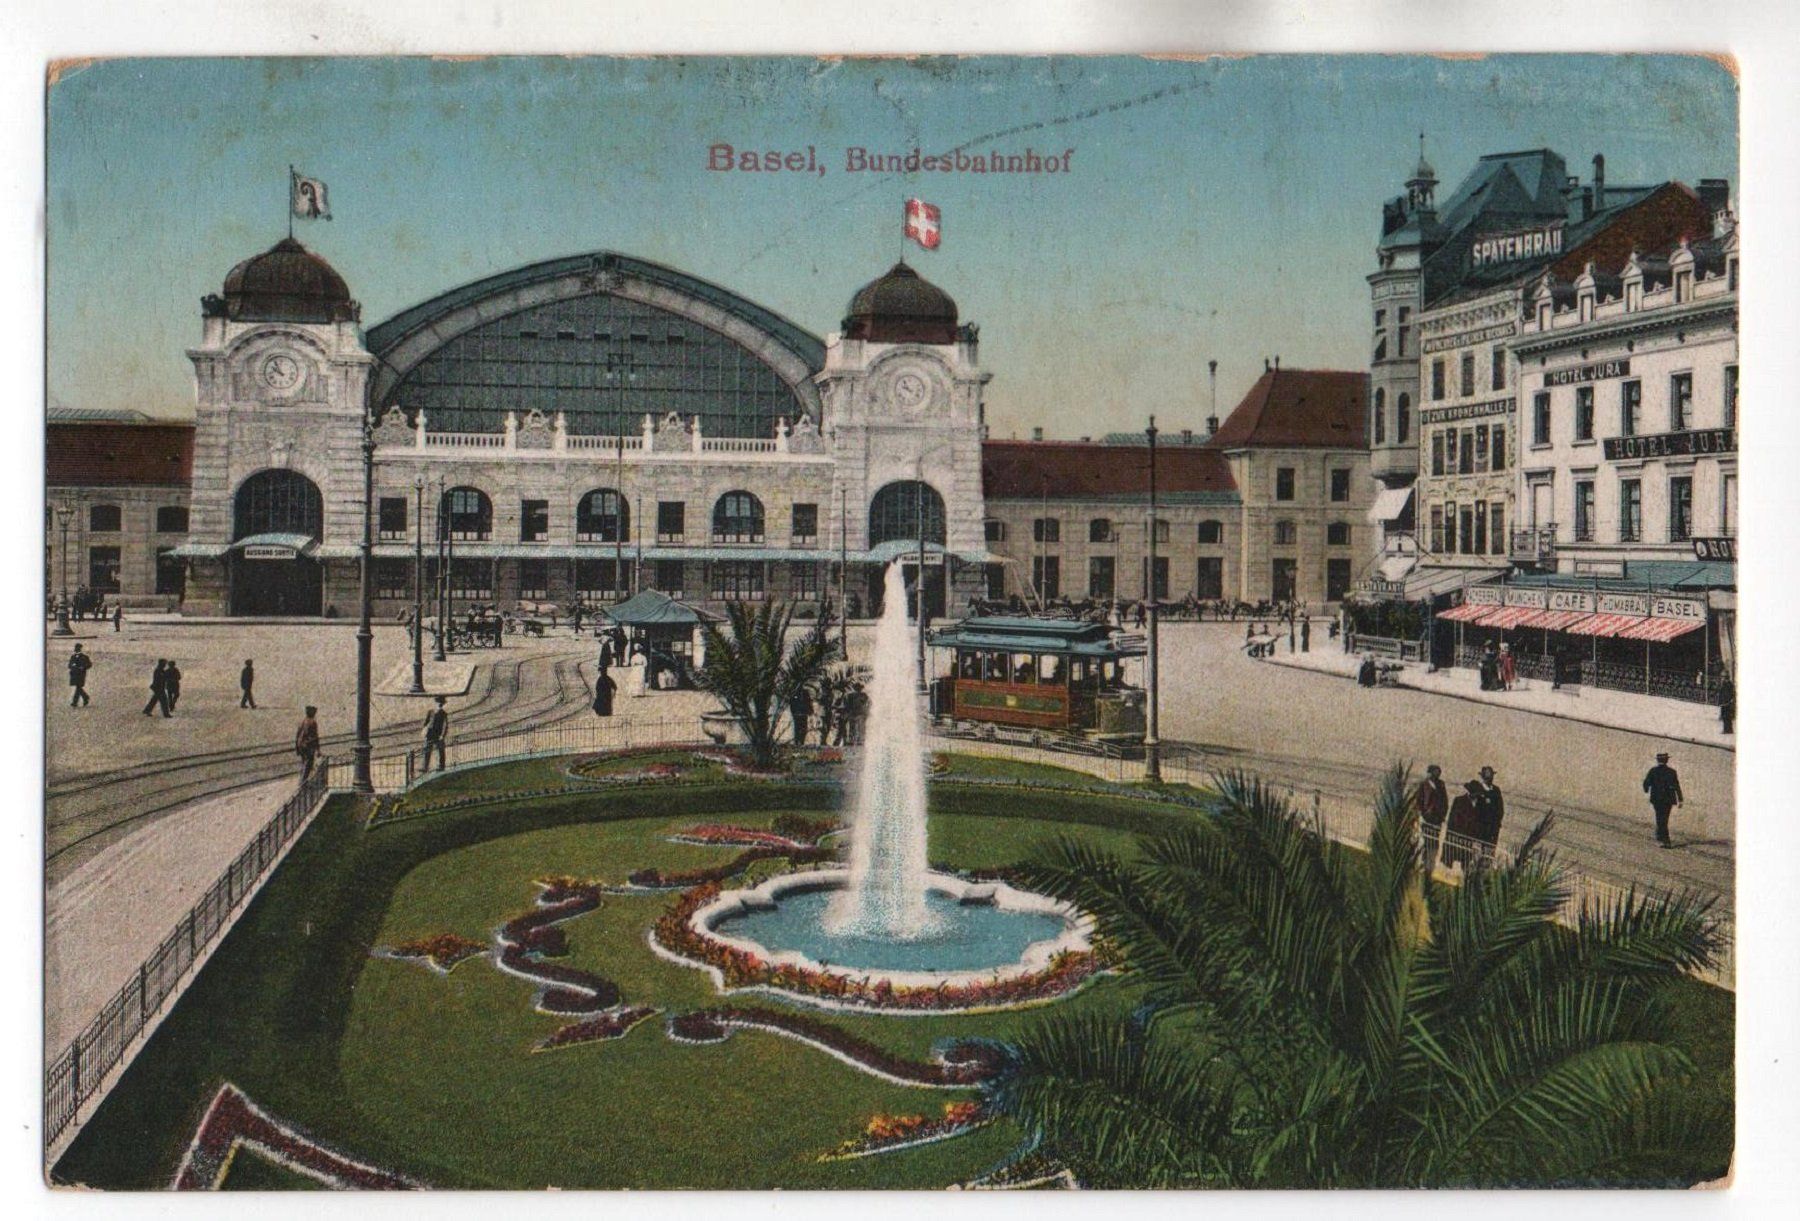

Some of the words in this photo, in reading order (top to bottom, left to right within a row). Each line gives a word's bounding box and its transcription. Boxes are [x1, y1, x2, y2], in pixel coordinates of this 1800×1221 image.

[1552, 366, 1586, 385] HOTEL
[1590, 360, 1621, 378] JURA
[1614, 436, 1672, 459] HOTEL
[1657, 600, 1699, 617] BASEL
